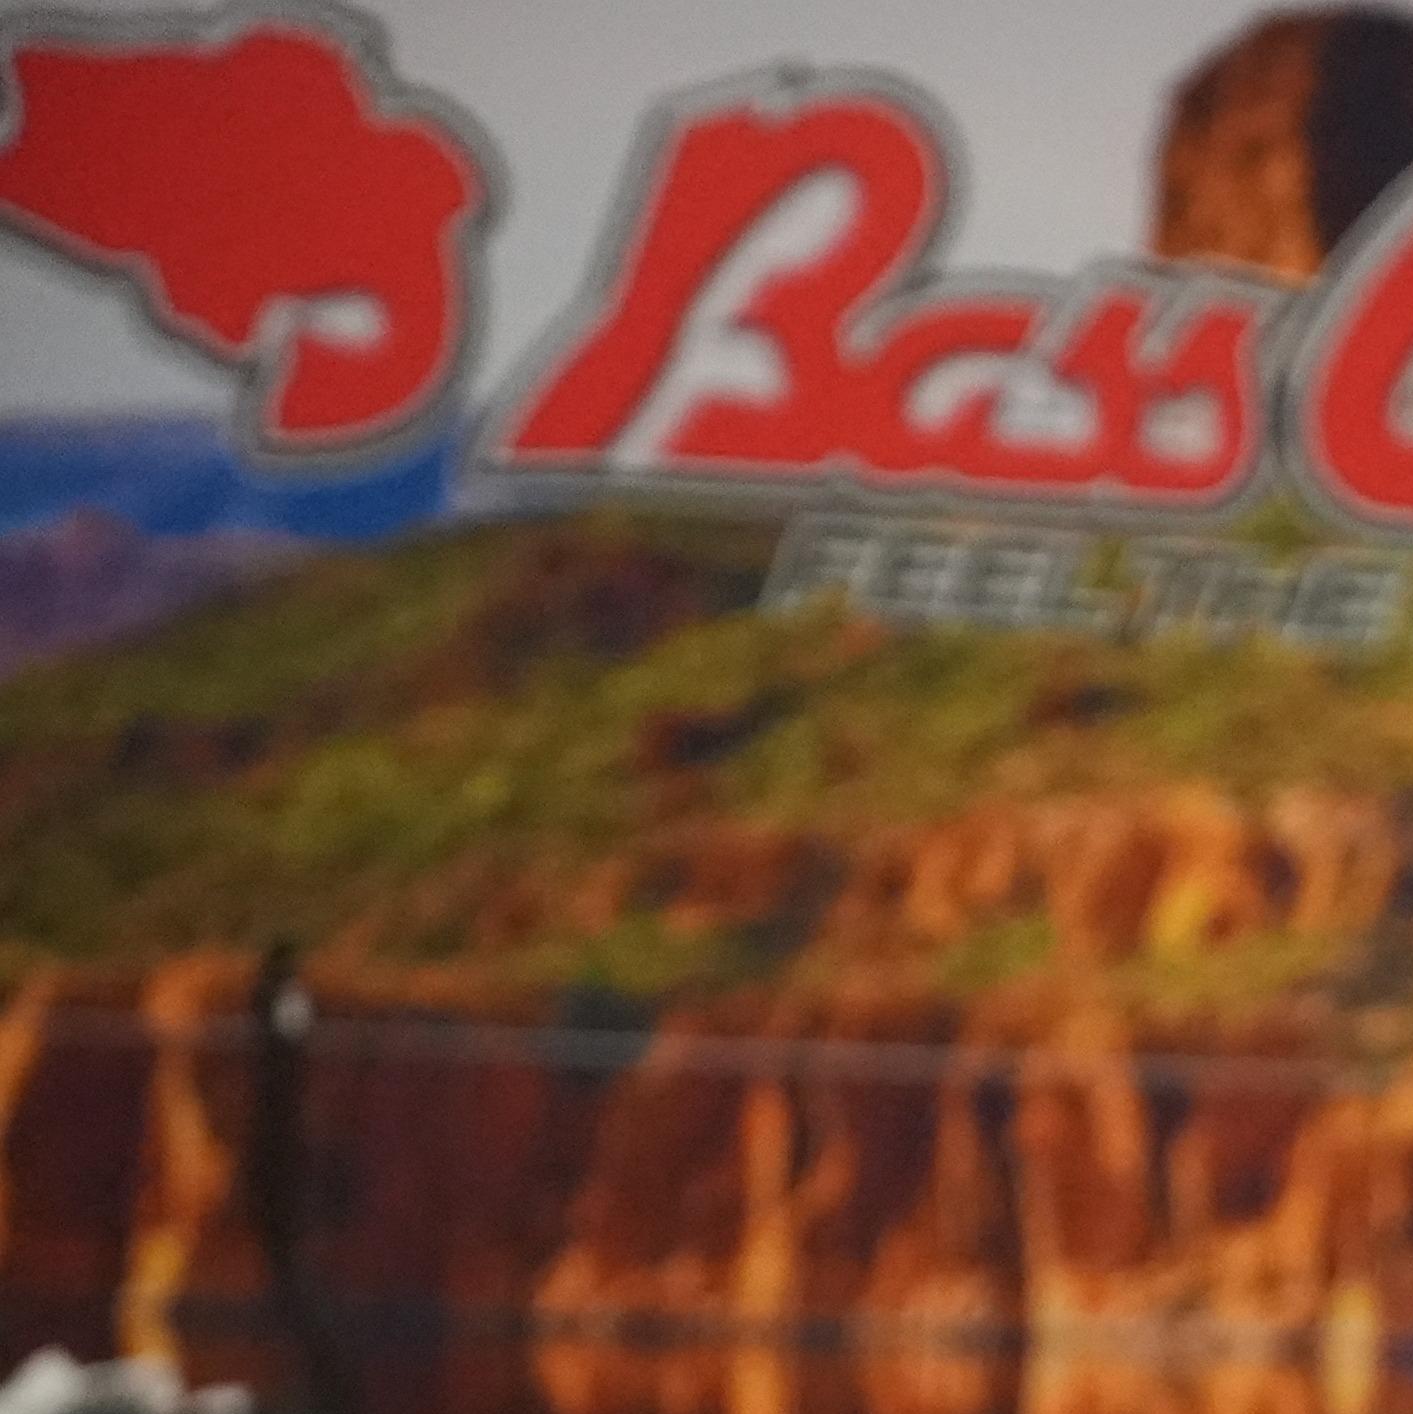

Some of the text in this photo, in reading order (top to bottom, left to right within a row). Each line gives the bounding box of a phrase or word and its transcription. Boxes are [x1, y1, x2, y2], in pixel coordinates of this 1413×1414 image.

[500, 90, 1262, 505] Bass
[780, 525, 1112, 625] FEEL
[1122, 545, 1398, 645] THE
